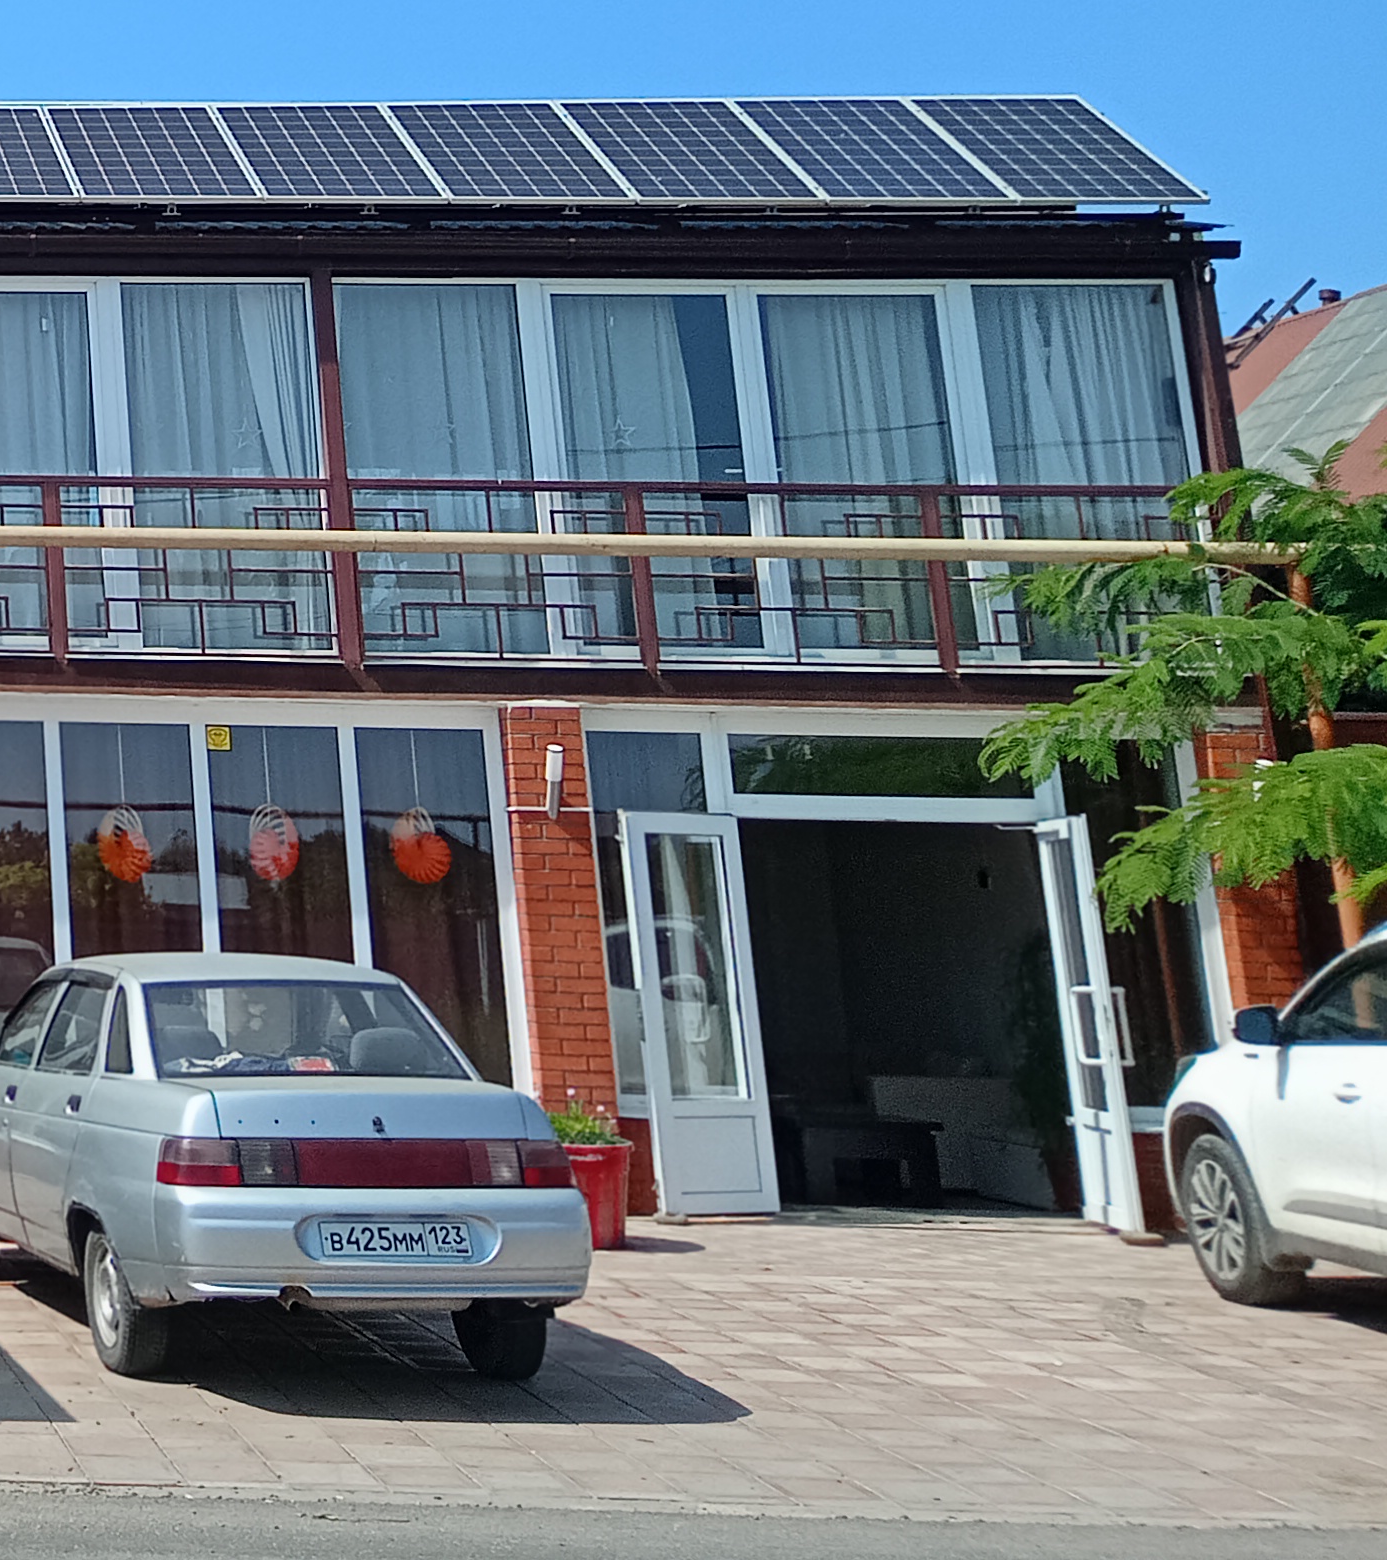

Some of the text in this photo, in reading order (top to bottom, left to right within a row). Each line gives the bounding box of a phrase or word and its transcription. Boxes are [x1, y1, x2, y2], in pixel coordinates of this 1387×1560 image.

[330, 1226, 463, 1252] В425ММ 123
[437, 1245, 456, 1253] RUS
